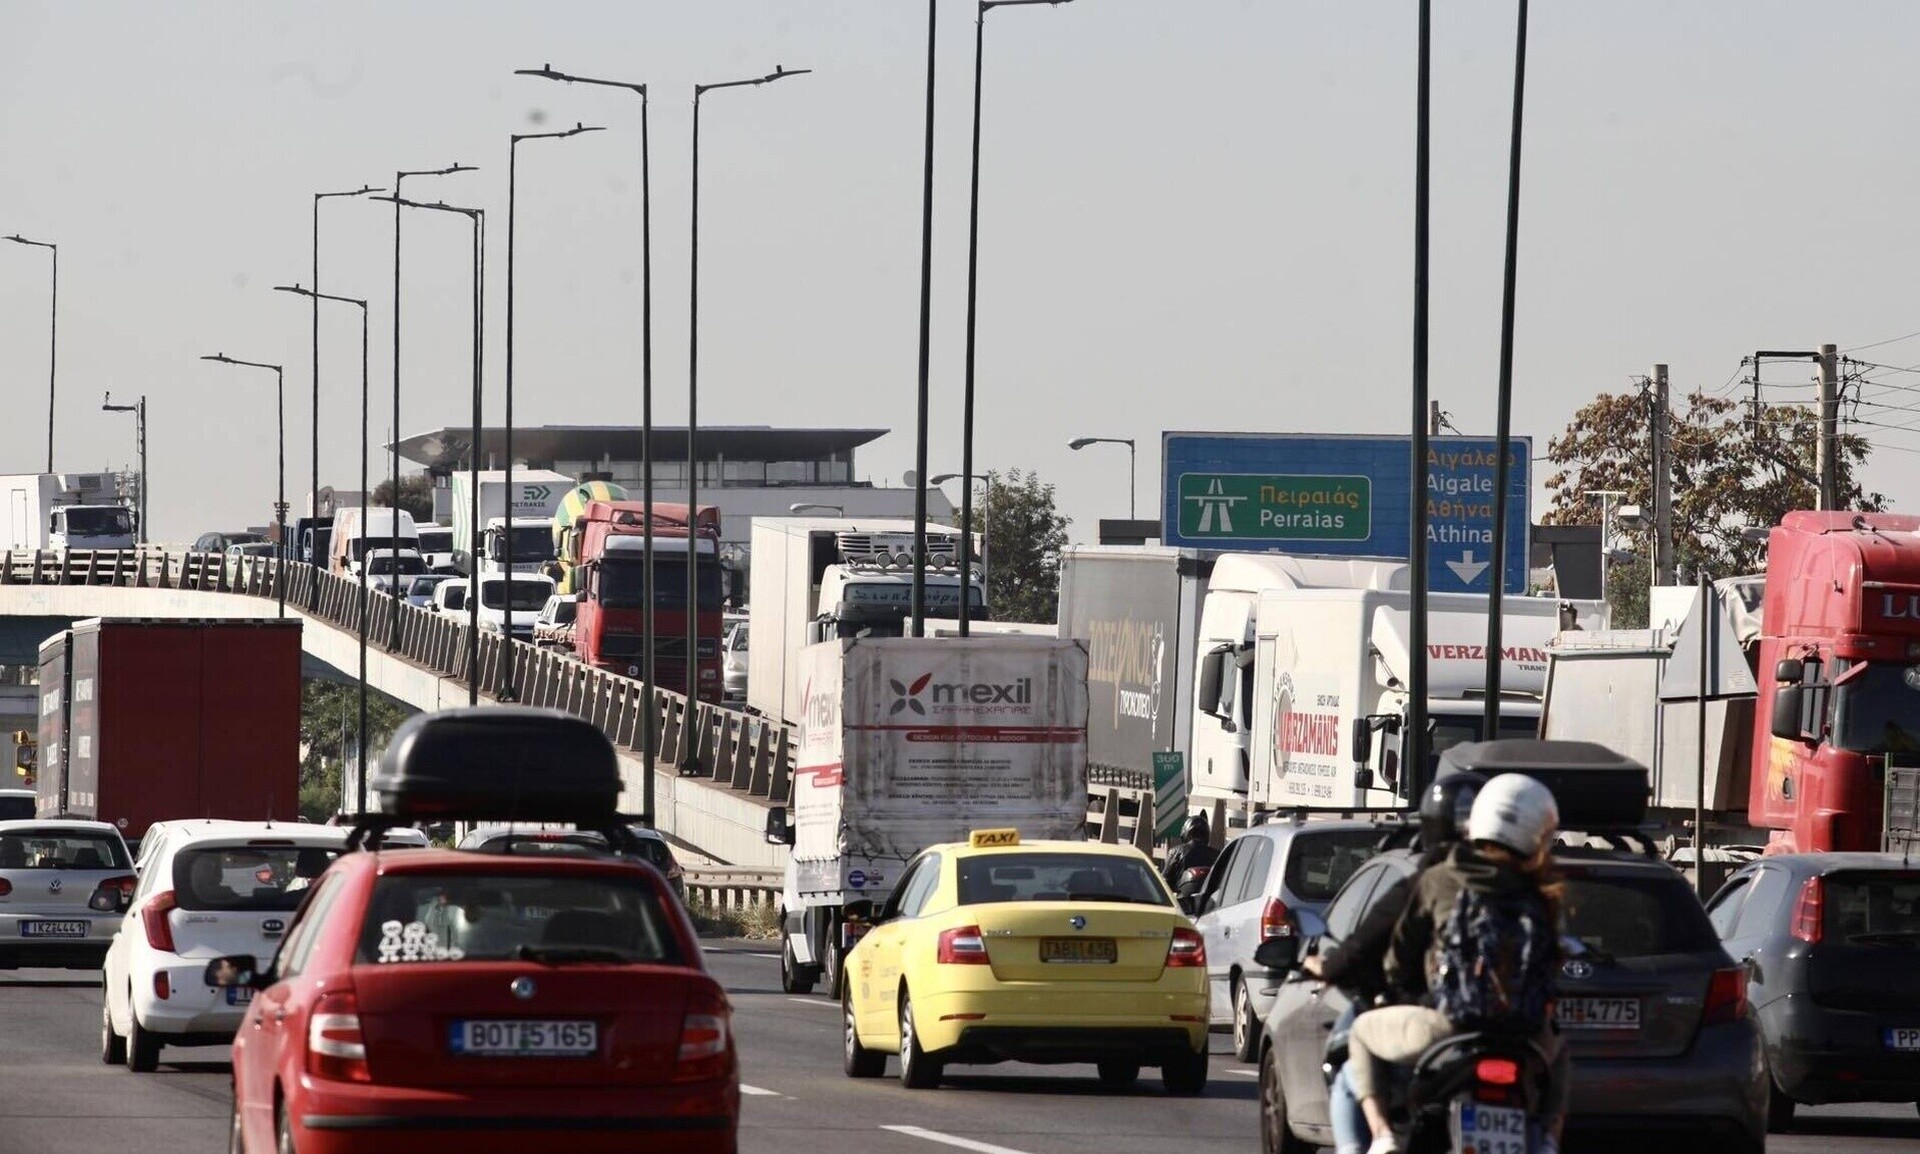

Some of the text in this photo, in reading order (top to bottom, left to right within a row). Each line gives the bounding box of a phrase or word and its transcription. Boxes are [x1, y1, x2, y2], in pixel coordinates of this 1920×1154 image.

[1427, 474, 1492, 495] Aigale
[1260, 485, 1359, 509] Πειραιάς
[1260, 509, 1345, 528] Peiraias
[1426, 524, 1493, 543] Athina
[1427, 645, 1547, 662] VERZMAN
[932, 677, 1031, 704] mexil
[976, 832, 1015, 844] TAXI
